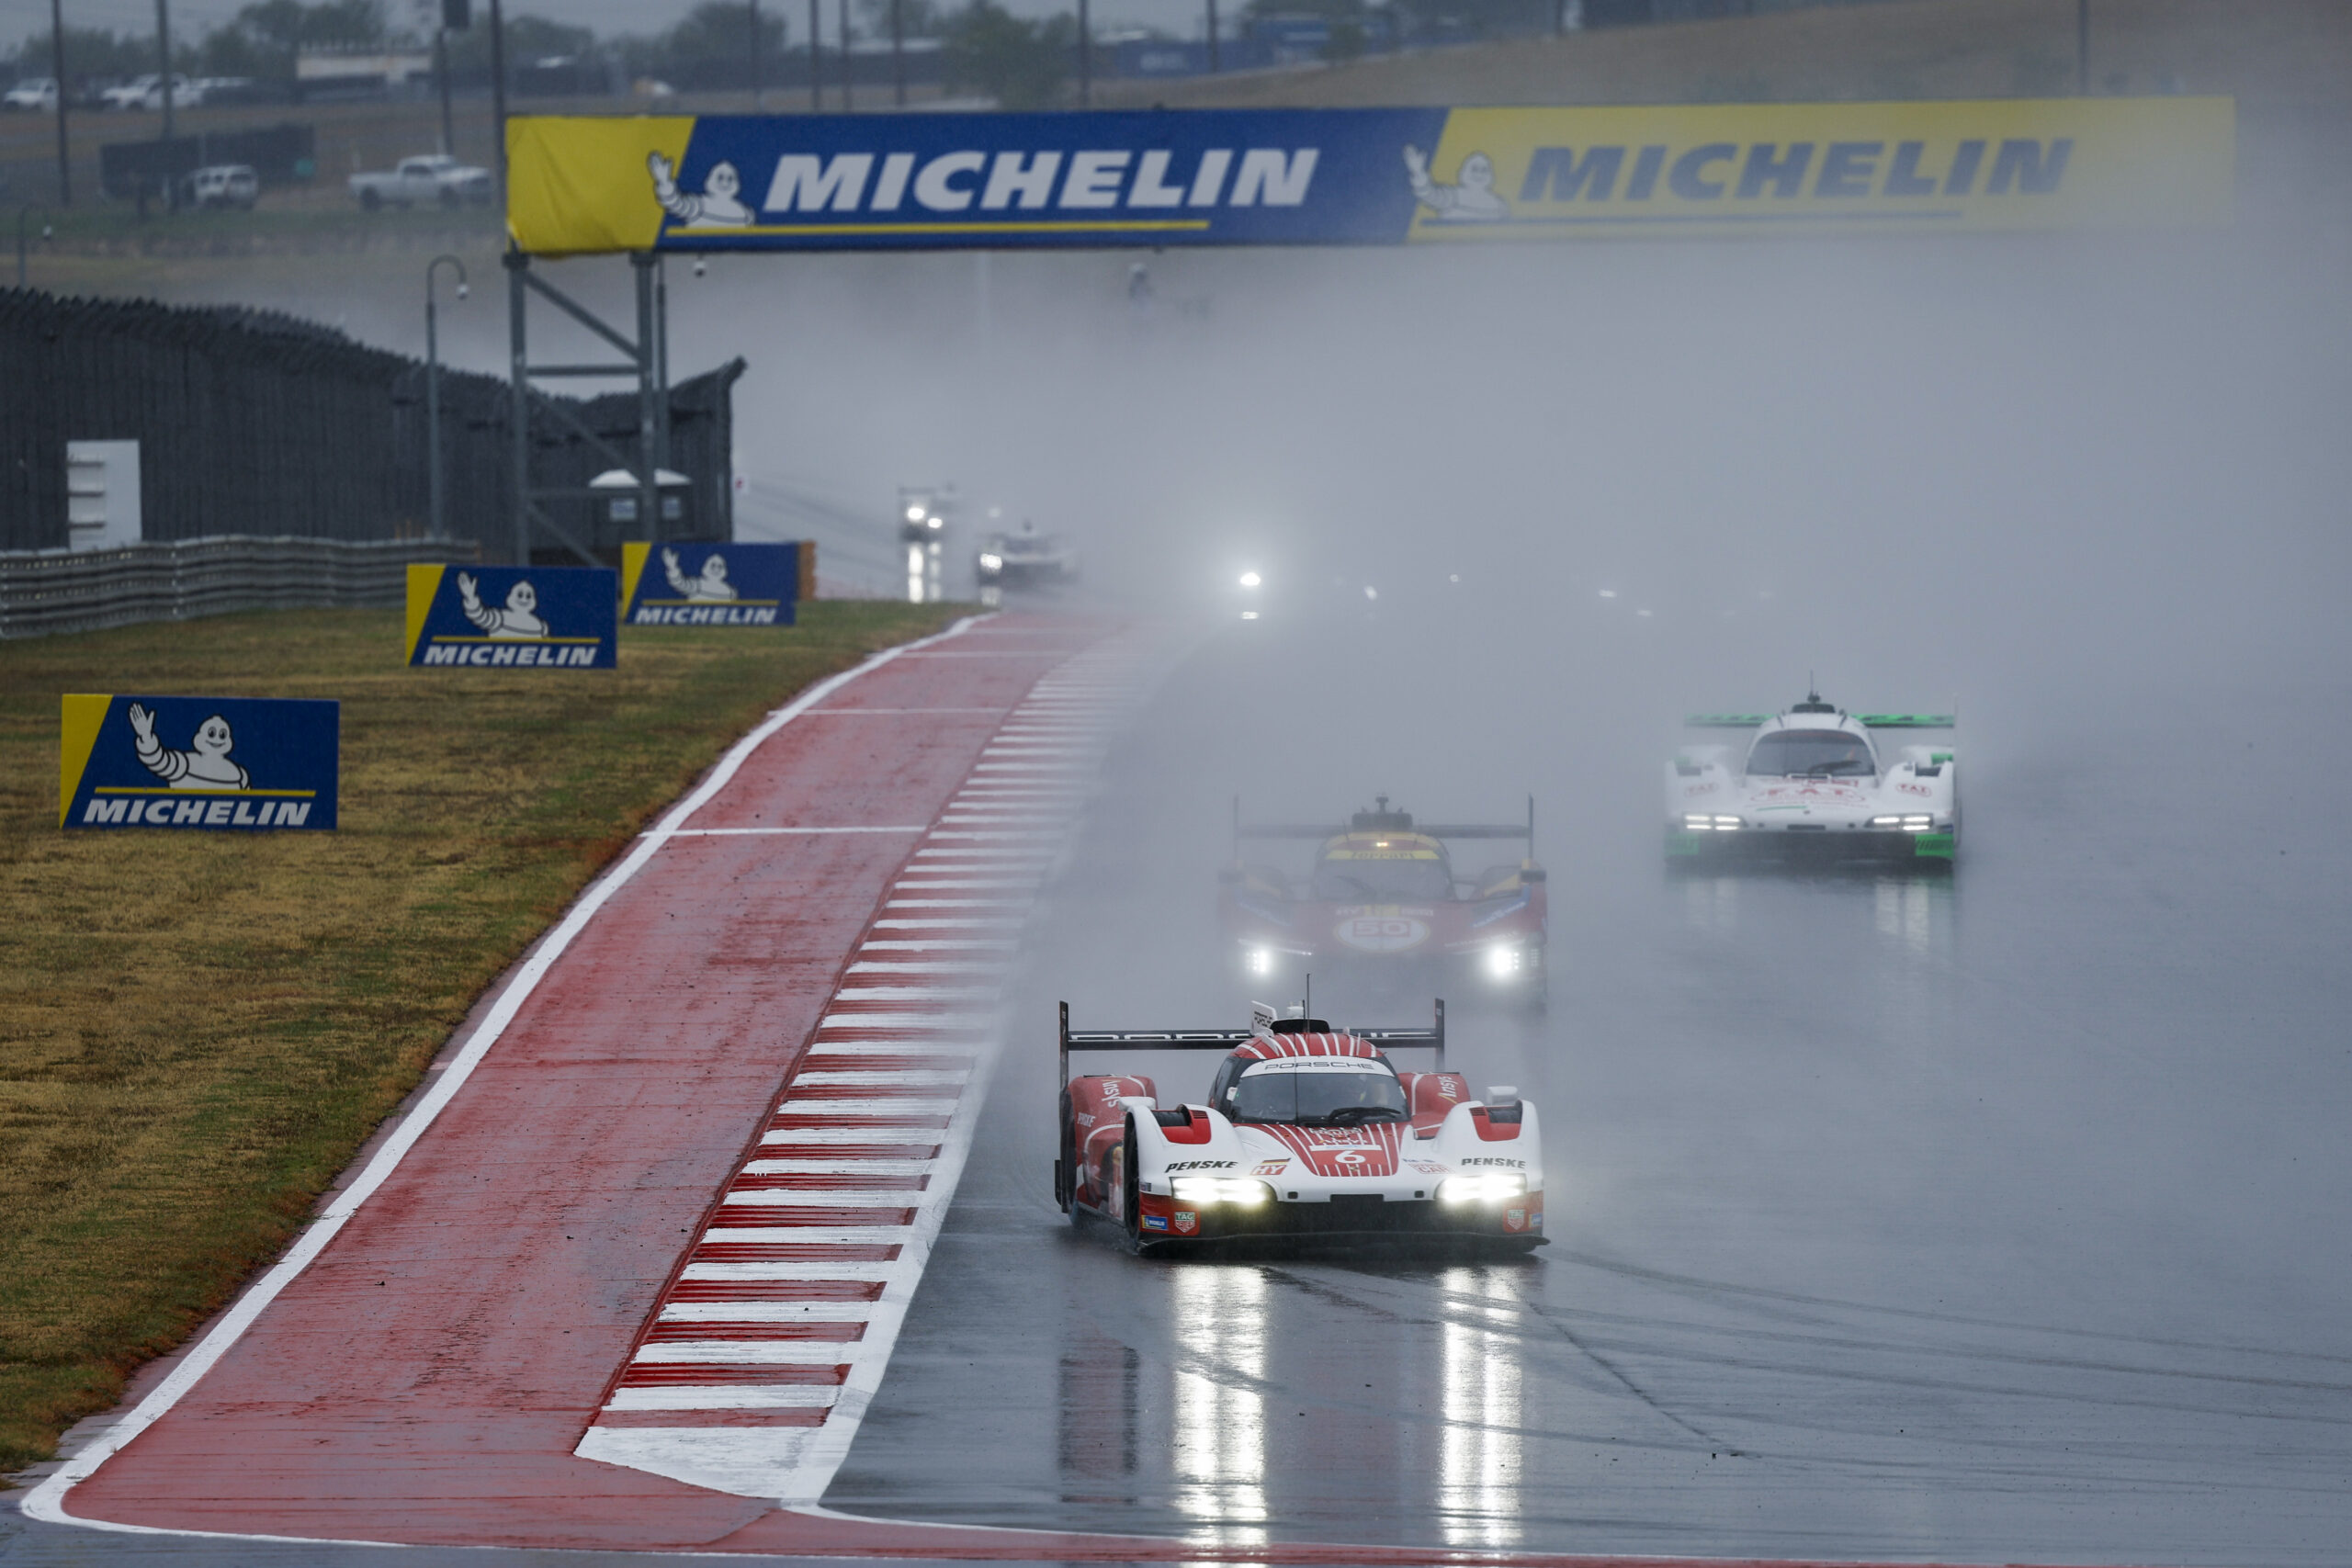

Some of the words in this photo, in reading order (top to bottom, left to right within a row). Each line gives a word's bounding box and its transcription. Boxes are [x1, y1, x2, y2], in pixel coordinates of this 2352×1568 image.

[1516, 138, 2076, 203] MICHELIN
[763, 148, 1320, 213] MICHELIN
[634, 606, 777, 626] MICHELIN
[422, 643, 598, 668] MICHELIN
[83, 798, 312, 828] MICHELIN
[1355, 921, 1408, 934] 50
[1264, 1061, 1375, 1070] PORSCHE
[1335, 1150, 1366, 1164] 6
[1461, 1157, 1527, 1168] PENSKE
[1164, 1160, 1238, 1173] PENSKE
[1252, 1165, 1284, 1175] HY
[1176, 1213, 1193, 1221] TAG
